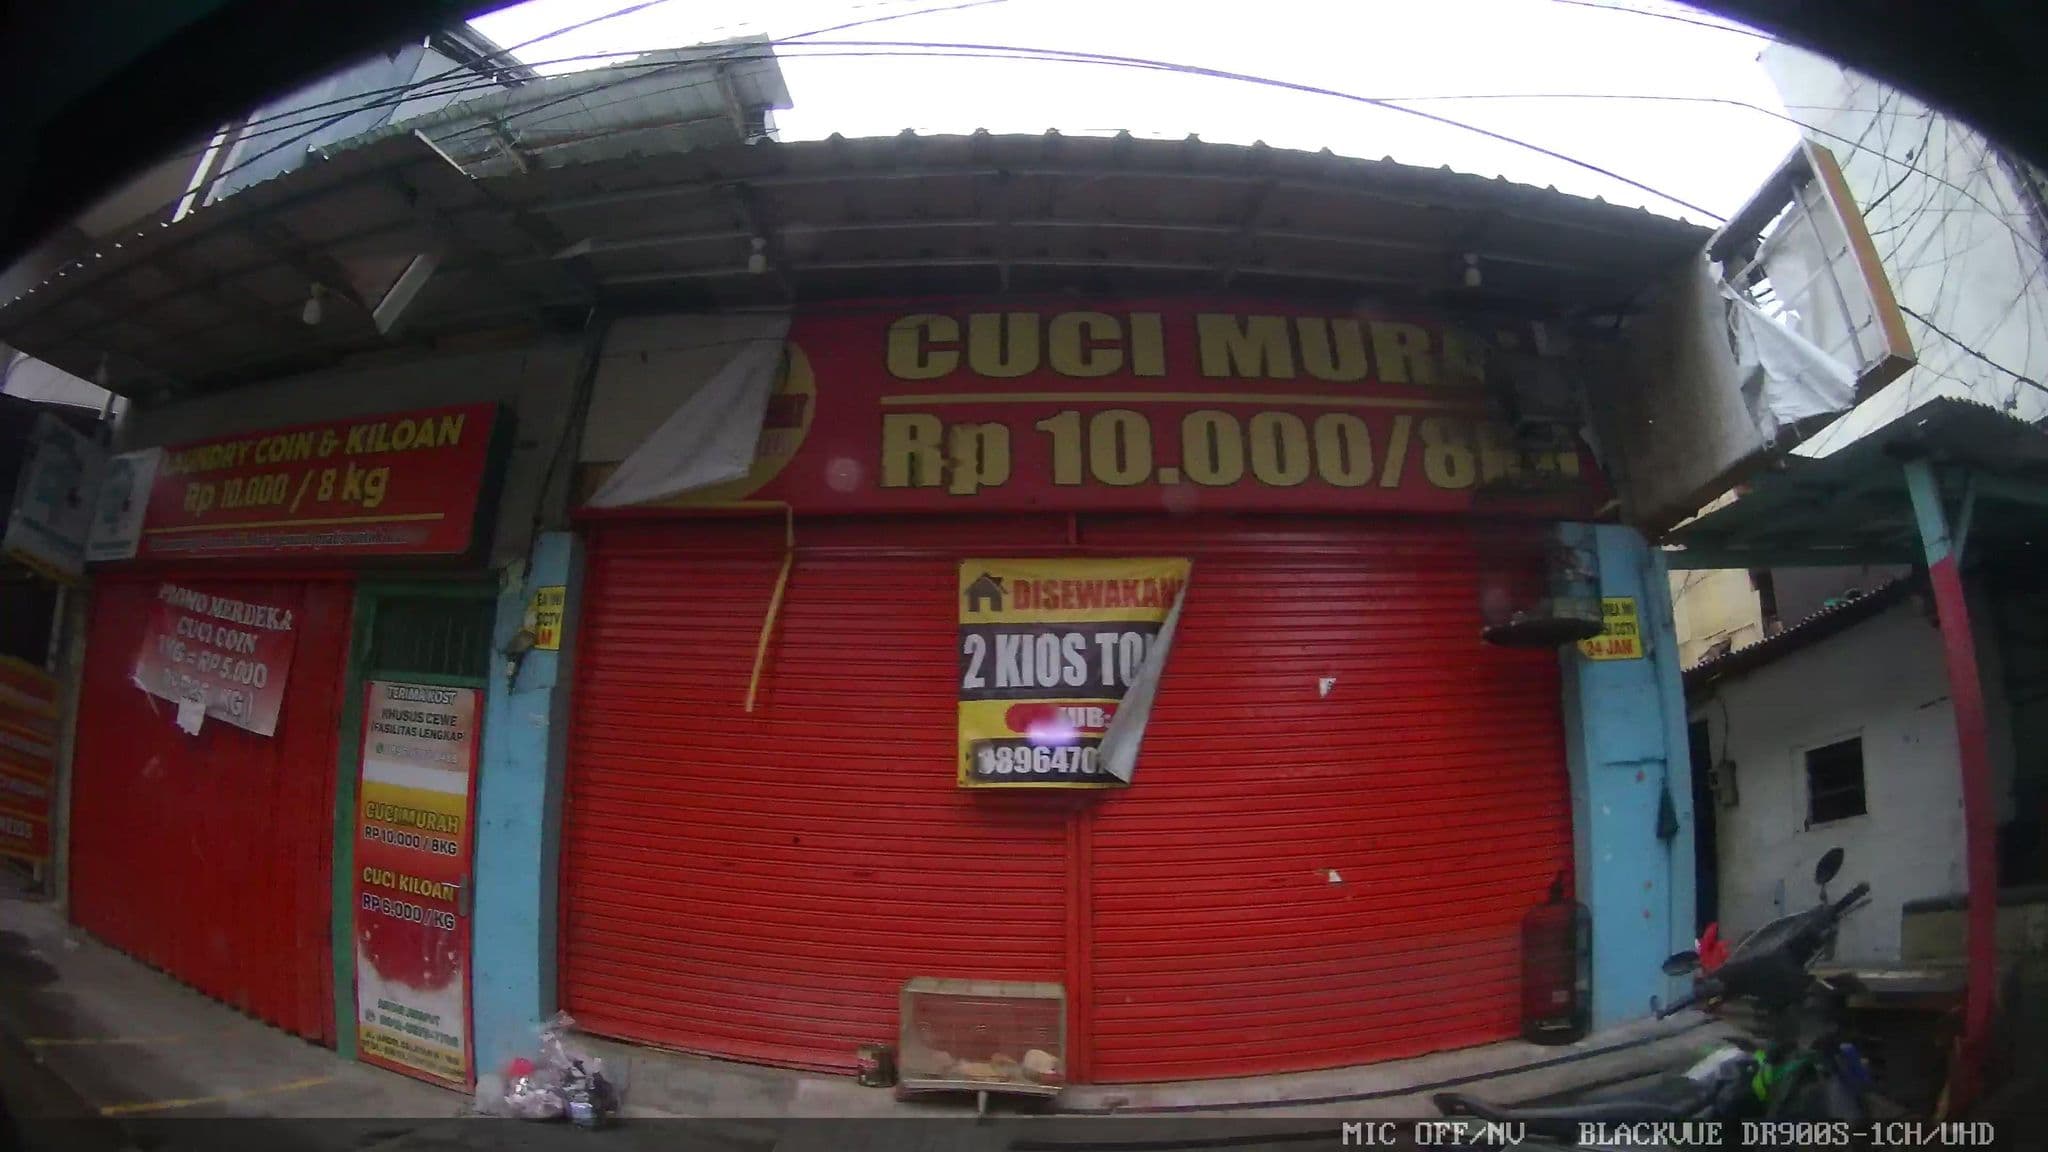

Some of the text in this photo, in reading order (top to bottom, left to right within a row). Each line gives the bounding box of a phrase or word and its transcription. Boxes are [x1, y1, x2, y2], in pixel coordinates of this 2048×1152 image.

[885, 310, 1166, 380] CUCI
[254, 432, 312, 465] COIN
[317, 429, 340, 457] &
[345, 413, 466, 455] KILOAN
[879, 411, 1011, 496] Rp
[183, 481, 216, 517] Rp
[316, 468, 338, 503] 8
[342, 461, 391, 508] kg
[208, 596, 293, 631] MERDEKA
[963, 631, 1161, 689] 2 KIOS TO
[426, 689, 458, 706] KOST
[426, 712, 458, 727] CEWE
[397, 807, 460, 834] MURAH
[364, 826, 380, 840] RP
[382, 828, 421, 849] 10.000
[431, 839, 457, 856] 8KG
[362, 866, 456, 902] CUCI KILOAN
[362, 892, 380, 912] RP
[433, 910, 457, 931] KG
